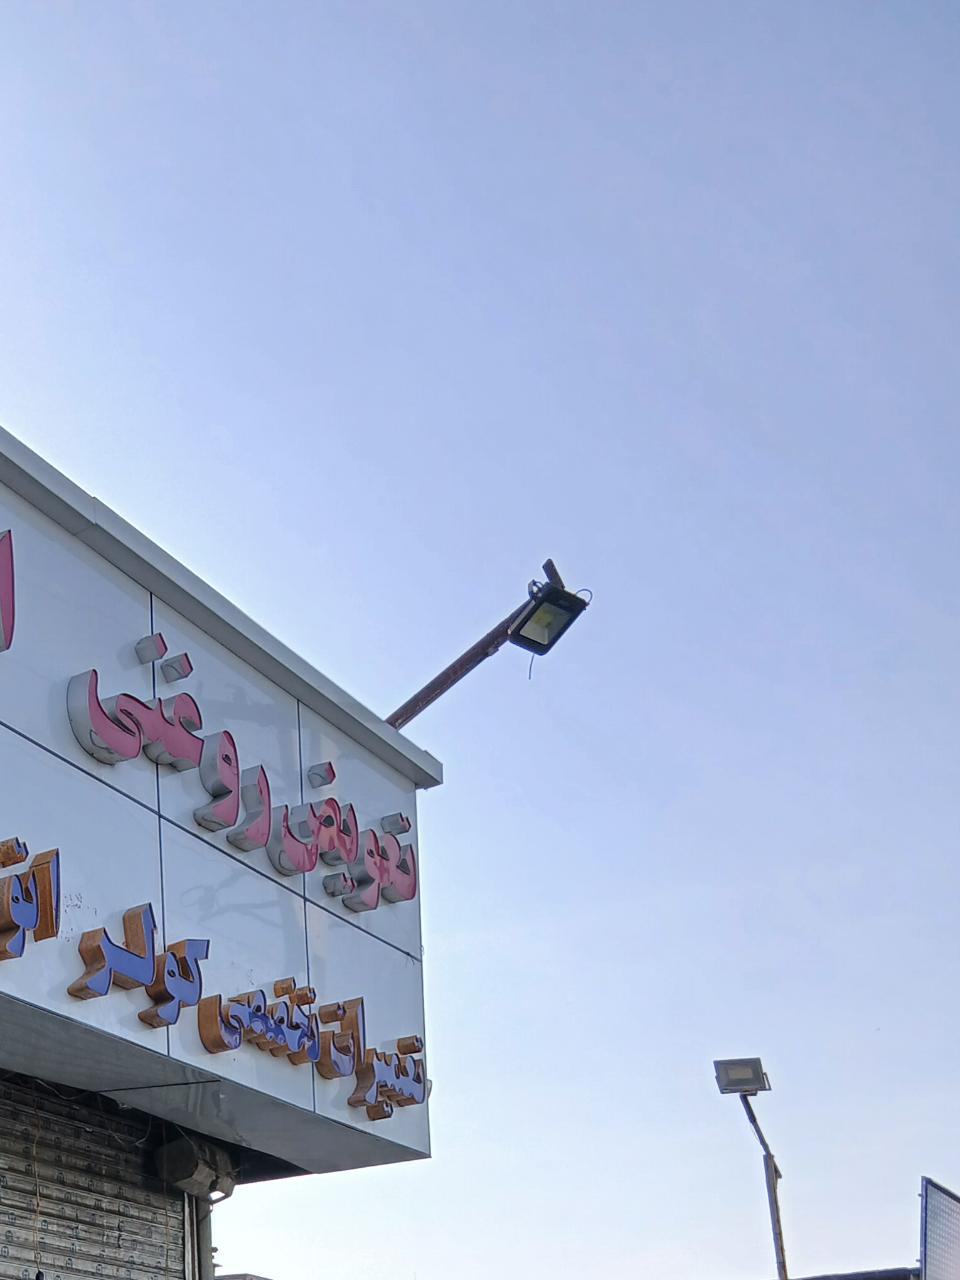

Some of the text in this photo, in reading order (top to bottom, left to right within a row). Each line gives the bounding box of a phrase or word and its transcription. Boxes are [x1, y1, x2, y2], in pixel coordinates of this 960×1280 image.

[67, 632, 272, 853] روغنی
[265, 761, 417, 913] تعویض
[67, 902, 210, 1029] کولر
[198, 976, 321, 1066] تخصصی
[315, 996, 426, 1121] تعمیرات
